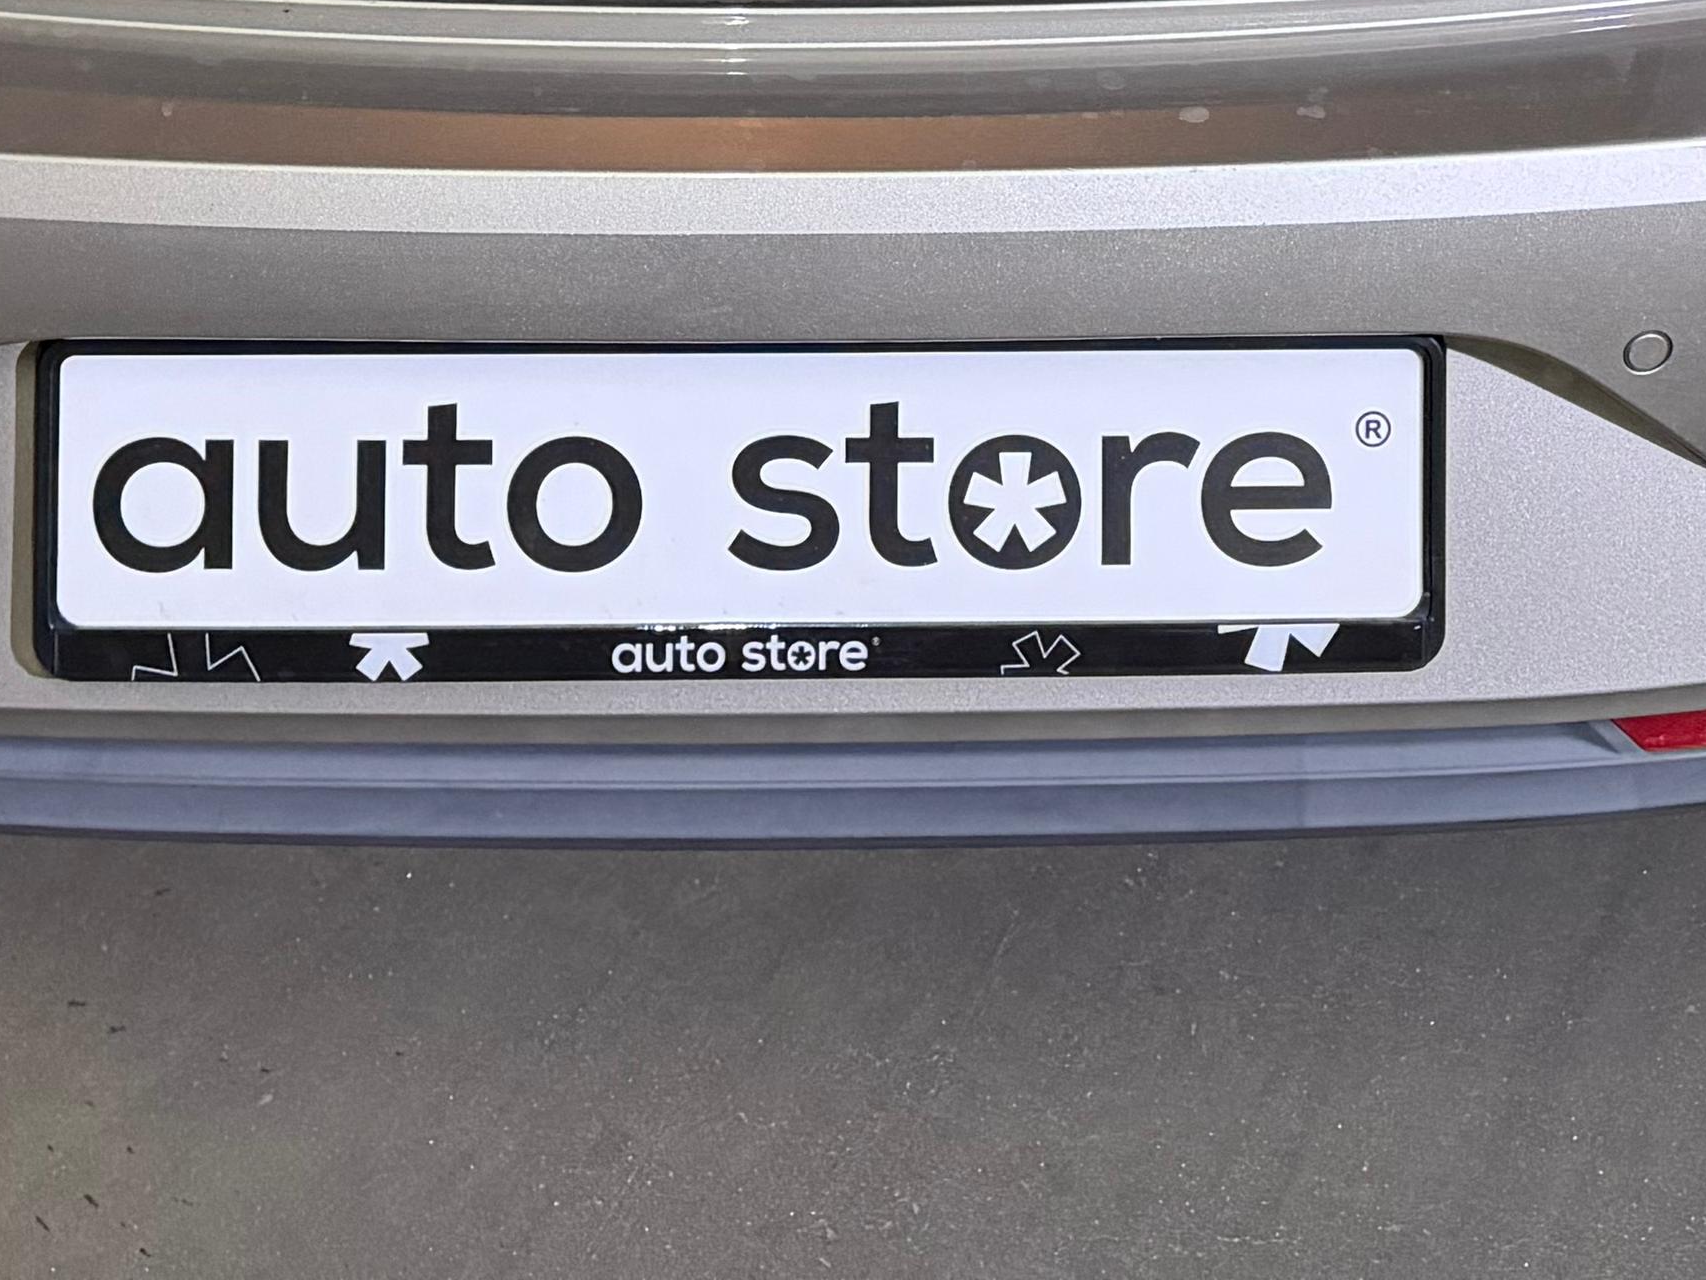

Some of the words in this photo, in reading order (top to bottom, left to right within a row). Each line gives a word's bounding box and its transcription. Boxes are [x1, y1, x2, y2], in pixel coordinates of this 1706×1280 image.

[92, 402, 643, 574] auto
[727, 401, 1333, 571] store
[611, 635, 726, 673] auto
[741, 634, 869, 672] store
